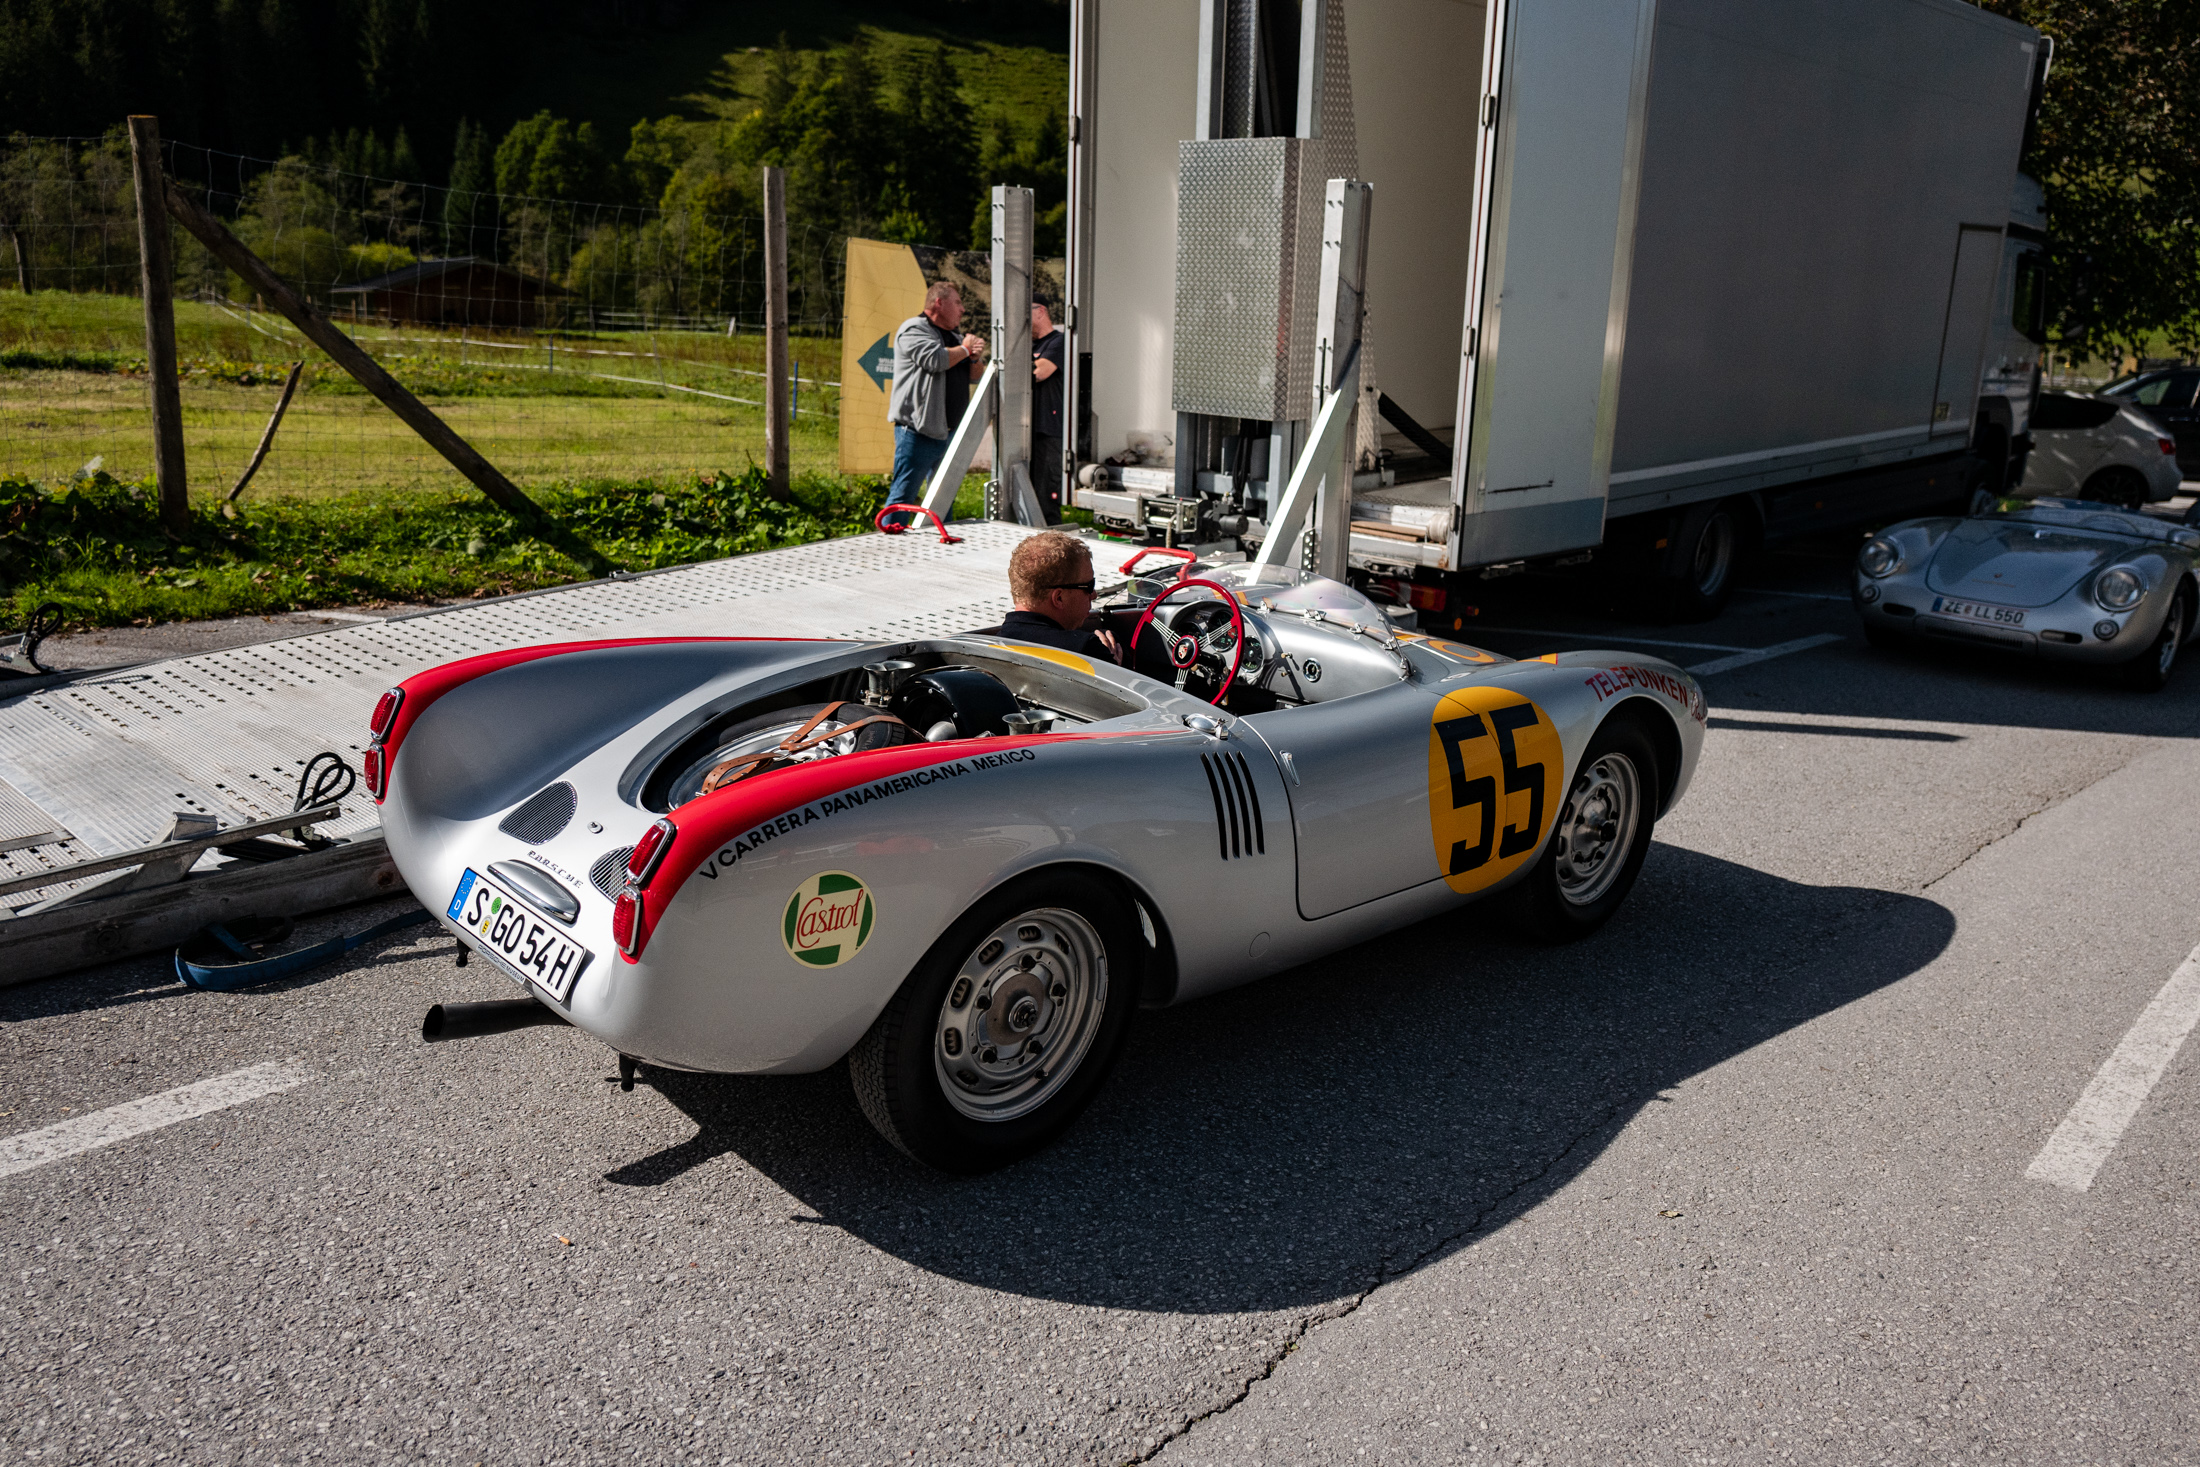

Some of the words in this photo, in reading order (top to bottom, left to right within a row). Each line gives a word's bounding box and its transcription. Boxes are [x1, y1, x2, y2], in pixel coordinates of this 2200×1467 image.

[1944, 601, 1963, 614] ZE
[1973, 606, 1991, 620] LL
[1994, 609, 2024, 624] 550
[1584, 666, 1688, 708] TELEFUNKEN
[1433, 702, 1545, 876] 55
[699, 861, 719, 881] V
[718, 807, 820, 867] CARRERA
[820, 763, 970, 817] PANAMERICANA
[971, 749, 1036, 772] MEXICO
[527, 849, 584, 888] PORSCHE
[453, 898, 461, 911] D
[796, 889, 864, 949] Castrol
[467, 887, 490, 926] S
[490, 903, 525, 954] GO
[519, 923, 575, 991] 54H
[477, 944, 507, 969] PORSCHE
[506, 965, 525, 983] MUSEUM
